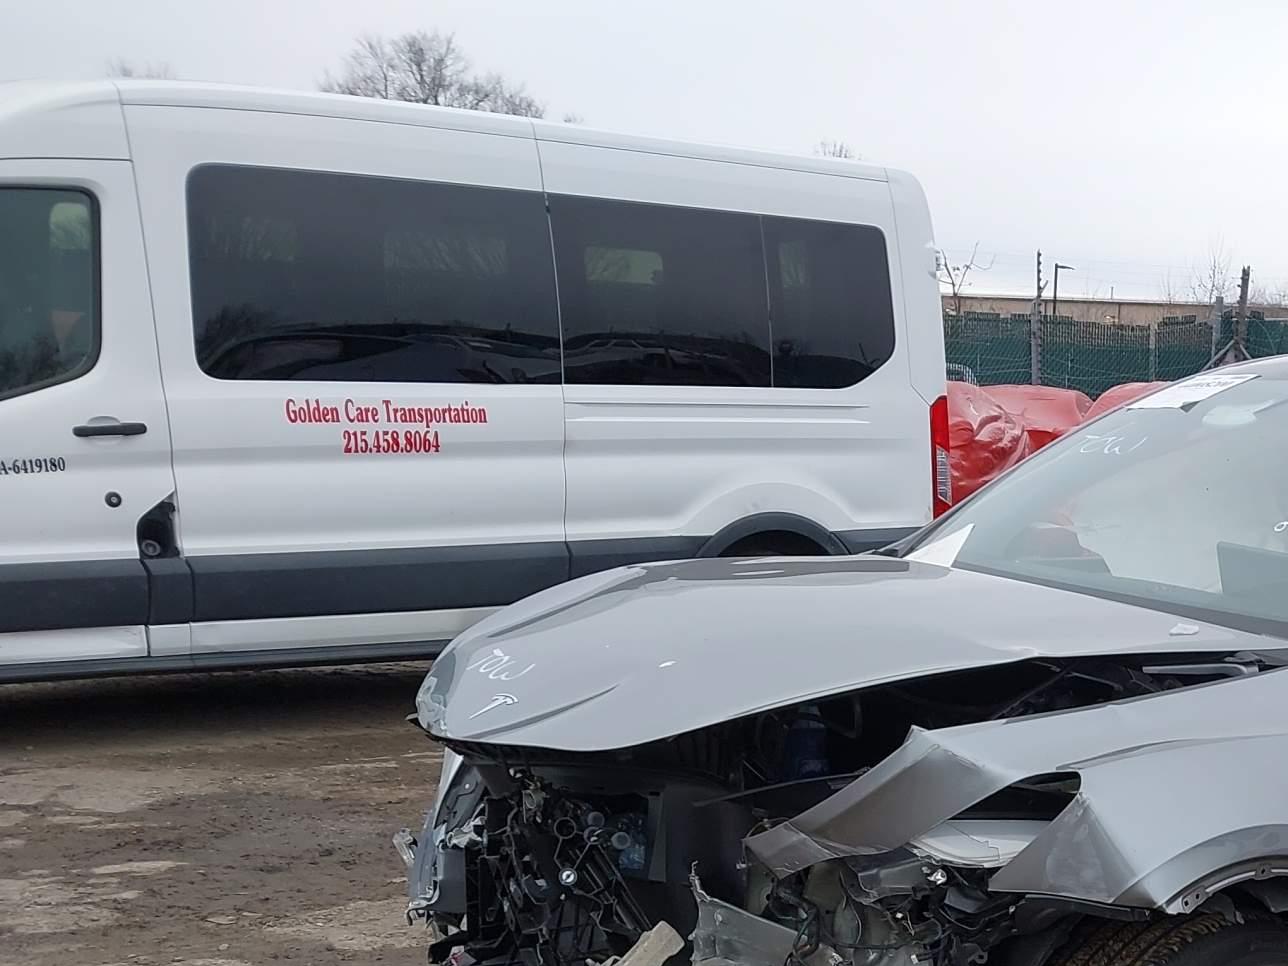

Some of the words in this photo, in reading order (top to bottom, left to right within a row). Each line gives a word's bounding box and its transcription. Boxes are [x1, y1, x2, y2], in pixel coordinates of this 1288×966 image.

[285, 398, 341, 424] Golden
[344, 398, 380, 424] Care
[382, 399, 488, 428] Transportation
[343, 430, 441, 454] 215.458.8064
